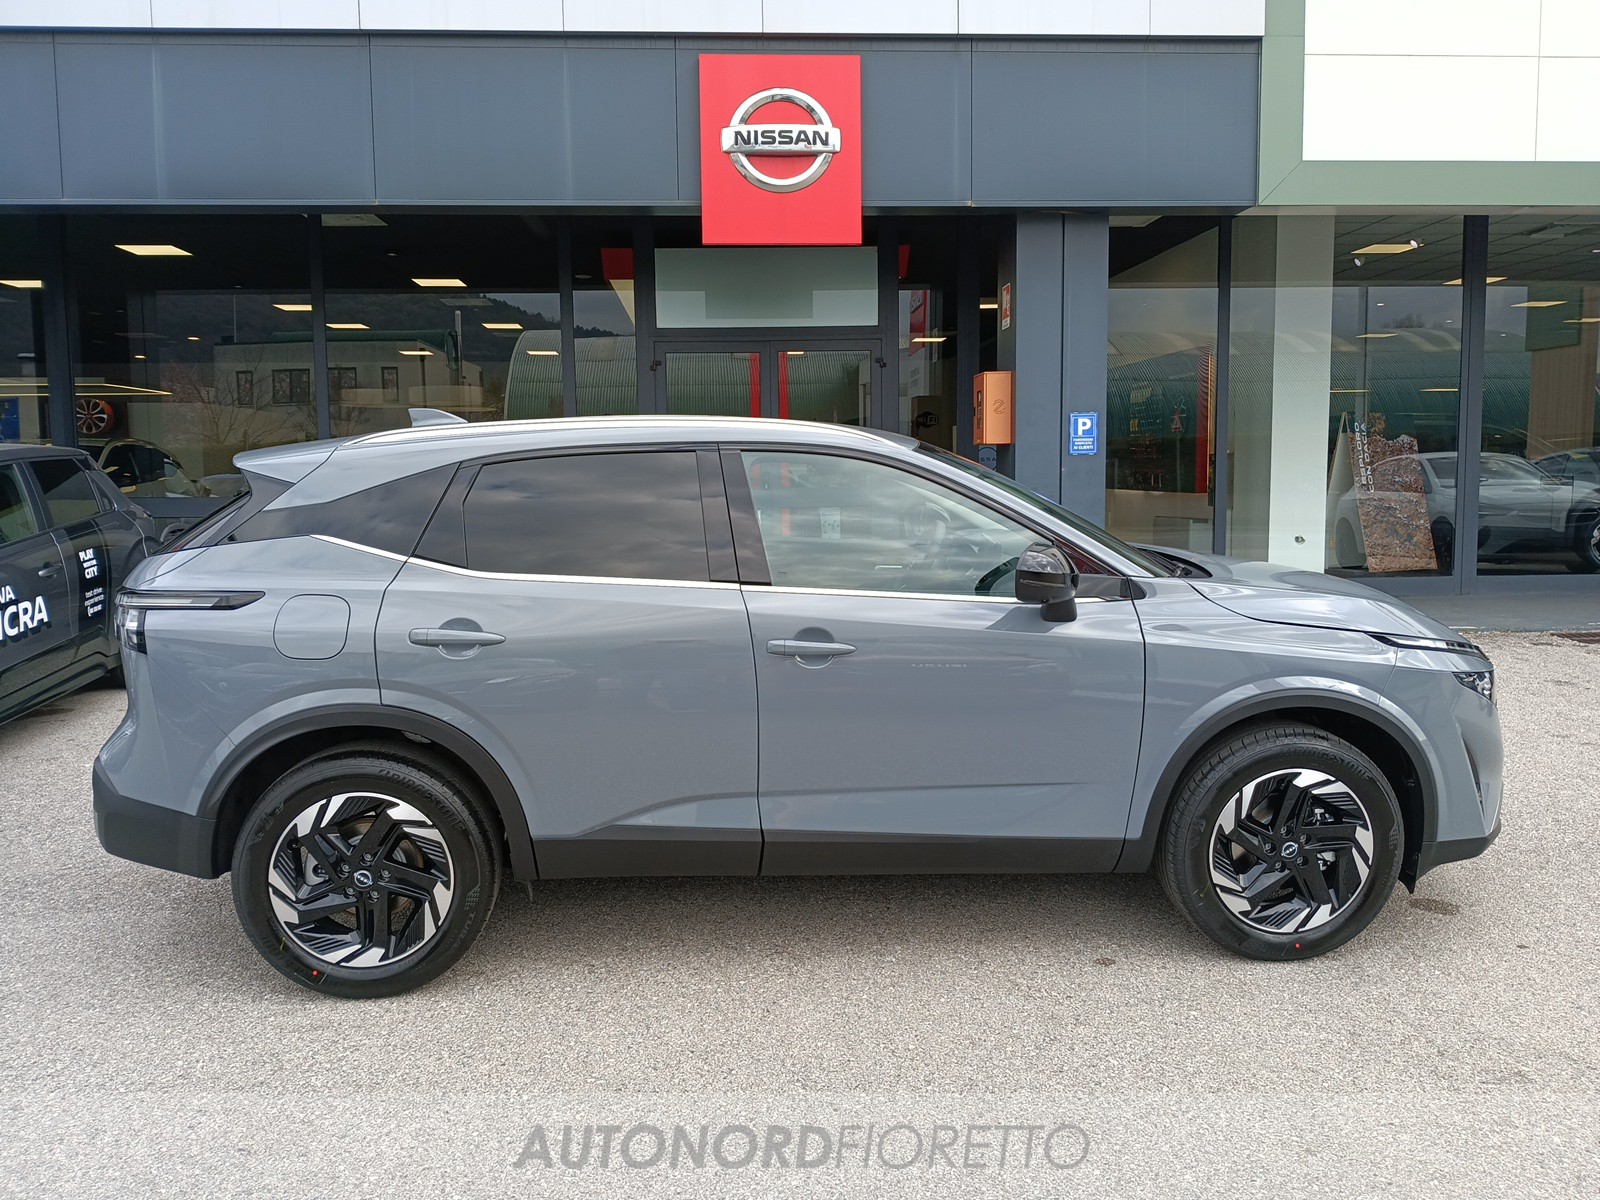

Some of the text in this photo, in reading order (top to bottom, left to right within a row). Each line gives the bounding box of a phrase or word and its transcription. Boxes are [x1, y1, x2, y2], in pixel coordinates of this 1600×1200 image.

[734, 130, 829, 146] NISSAN
[1077, 418, 1091, 436] P
[1360, 423, 1374, 493] CON DACIA
[78, 548, 94, 562] PLAY
[84, 566, 98, 579] CITY
[0, 595, 49, 641] ICRA
